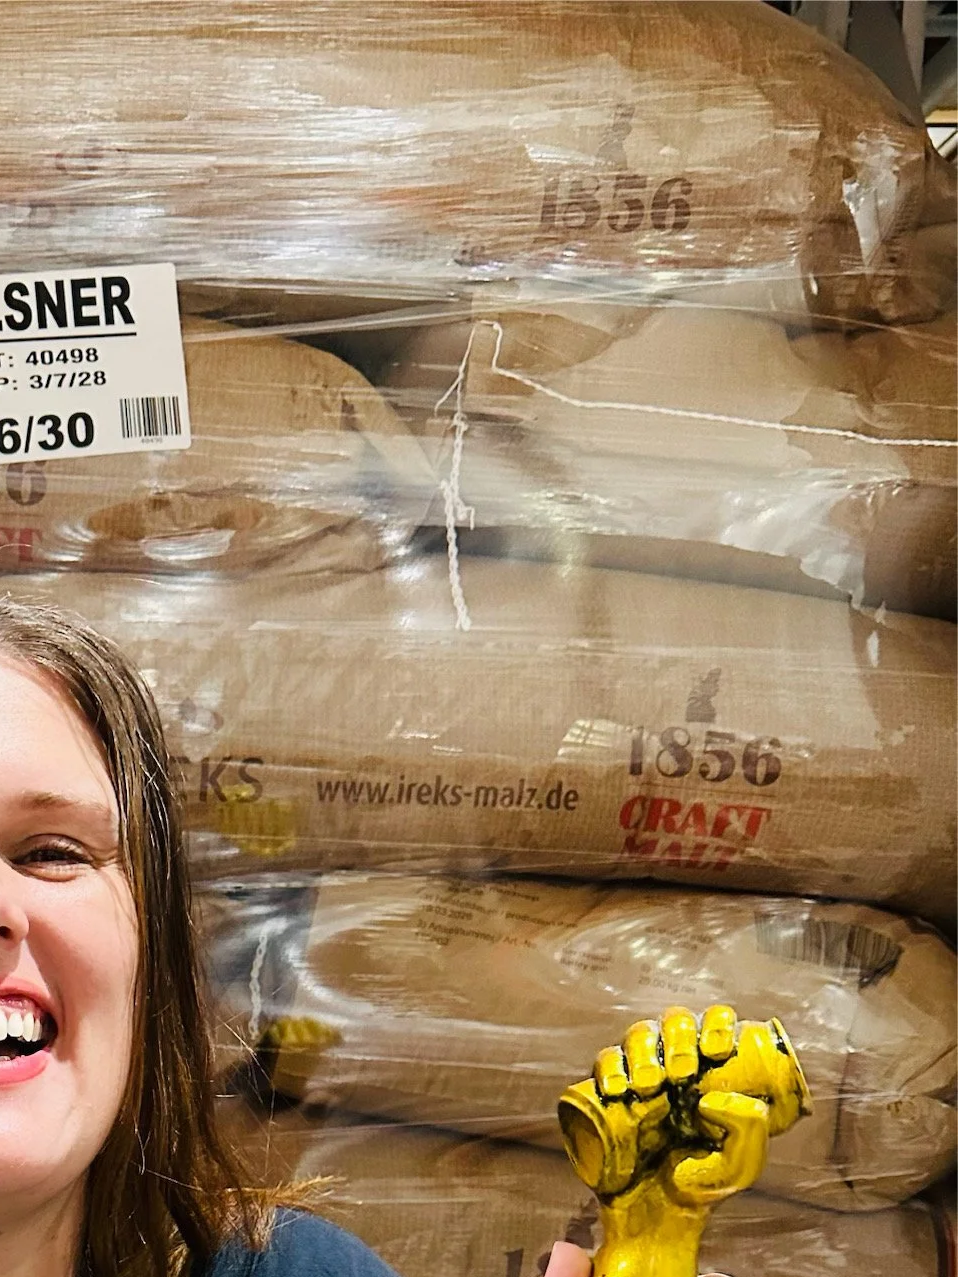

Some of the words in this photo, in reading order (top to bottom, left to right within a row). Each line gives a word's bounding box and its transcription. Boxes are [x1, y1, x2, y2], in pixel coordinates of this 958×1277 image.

[540, 174, 692, 233] 1856
[25, 347, 99, 367] 40498
[29, 371, 107, 390] 3/7/28
[628, 726, 782, 787] 1856
[316, 775, 580, 811] www.ireks-malz.de
[619, 793, 772, 842] CRAFT
